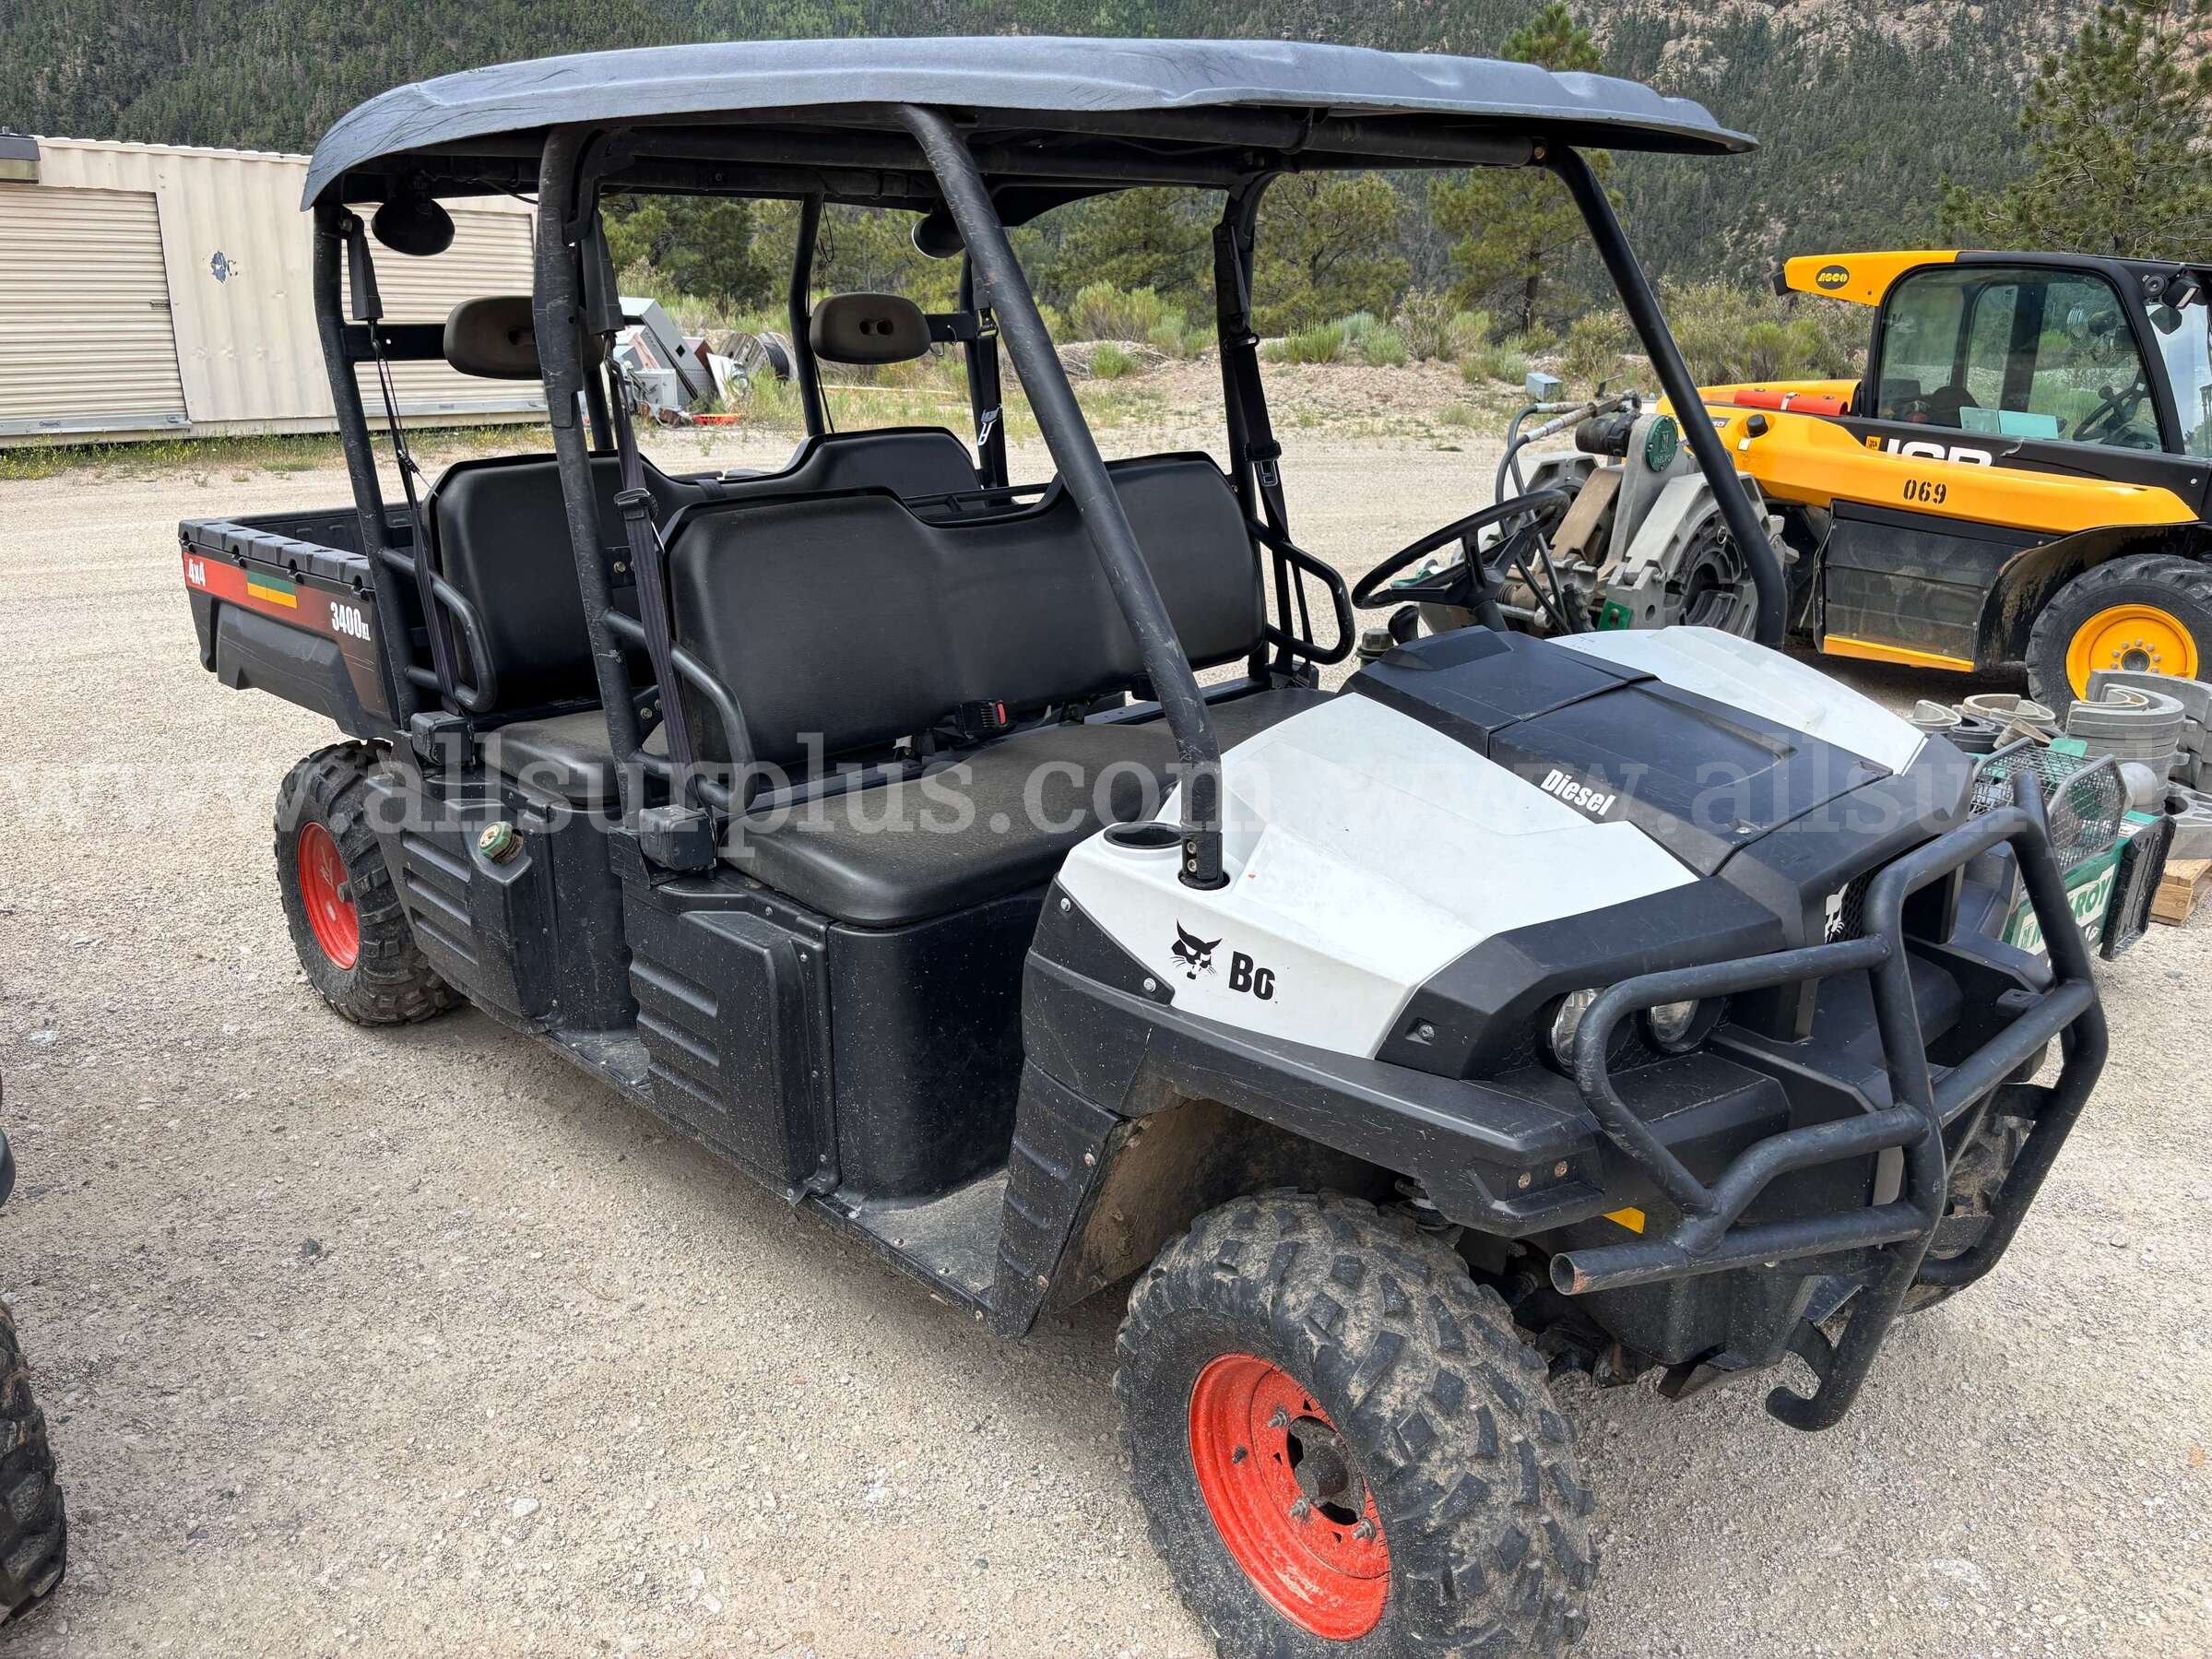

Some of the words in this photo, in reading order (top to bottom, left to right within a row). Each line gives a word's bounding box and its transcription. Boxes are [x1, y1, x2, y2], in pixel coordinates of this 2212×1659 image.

[1902, 479, 1947, 504] 069
[188, 559, 207, 587] 4x4
[1540, 768, 1616, 816] Diesel
